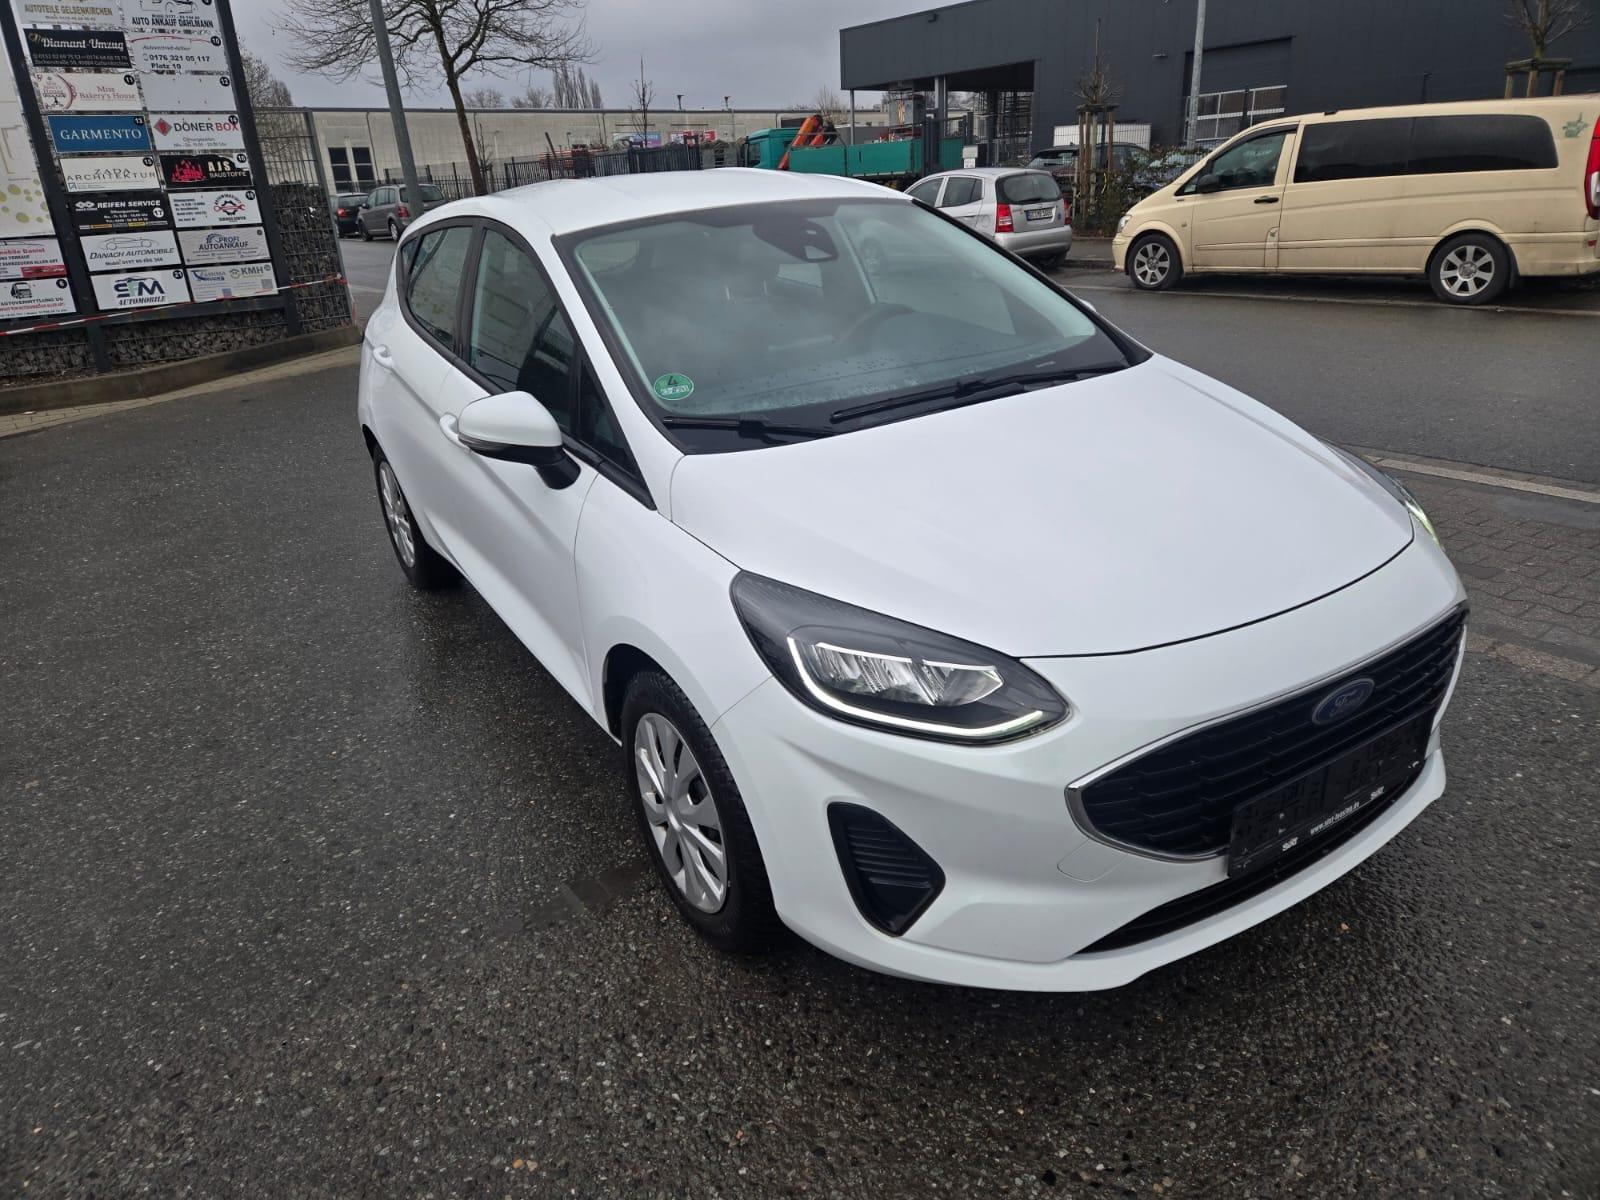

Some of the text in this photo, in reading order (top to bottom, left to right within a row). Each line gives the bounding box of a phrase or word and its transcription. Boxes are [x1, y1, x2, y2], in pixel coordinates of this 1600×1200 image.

[24, 4, 113, 16] AUTOTEILE GELSENKIRCHEN
[131, 16, 150, 26] AUTO
[151, 17, 177, 26] ANKAUF
[178, 18, 214, 28] DAHLMANN
[41, 38, 86, 49] Diamant
[215, 122, 239, 132] BOX
[60, 129, 142, 140] GARMENTO
[66, 172, 156, 181] ARCHITEKTUR
[97, 201, 126, 209] REIFEN
[198, 241, 249, 251] AUTOANKAUF
[90, 248, 175, 260] DANACH AUTOMOBILE
[240, 266, 264, 275] KMH
[118, 296, 166, 306] AUTOMOBILE
[668, 375, 679, 387] 4
